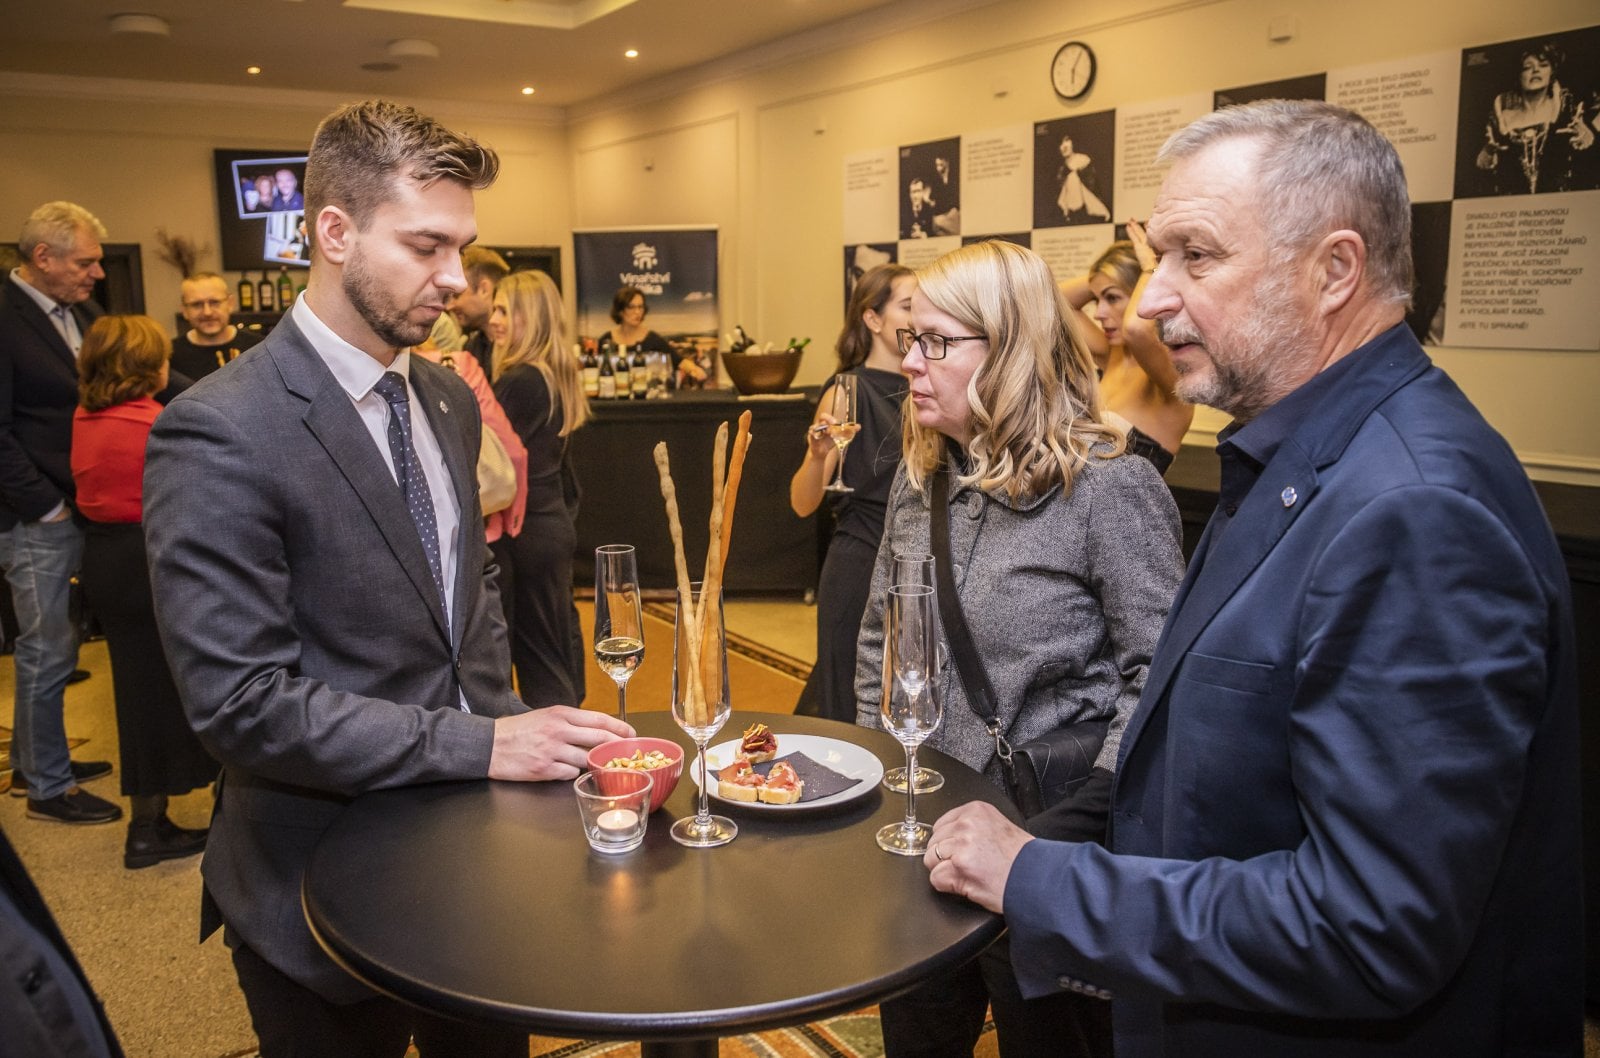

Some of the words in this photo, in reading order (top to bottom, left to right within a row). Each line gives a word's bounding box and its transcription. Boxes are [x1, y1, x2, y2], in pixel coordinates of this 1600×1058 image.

[1466, 212, 1498, 220] DIVADLO
[1500, 210, 1517, 218] POD
[1519, 208, 1569, 218] PALMOVKOU
[1528, 247, 1569, 256] ZÁKLADNÍ
[1531, 267, 1583, 276] SCHOPNOST
